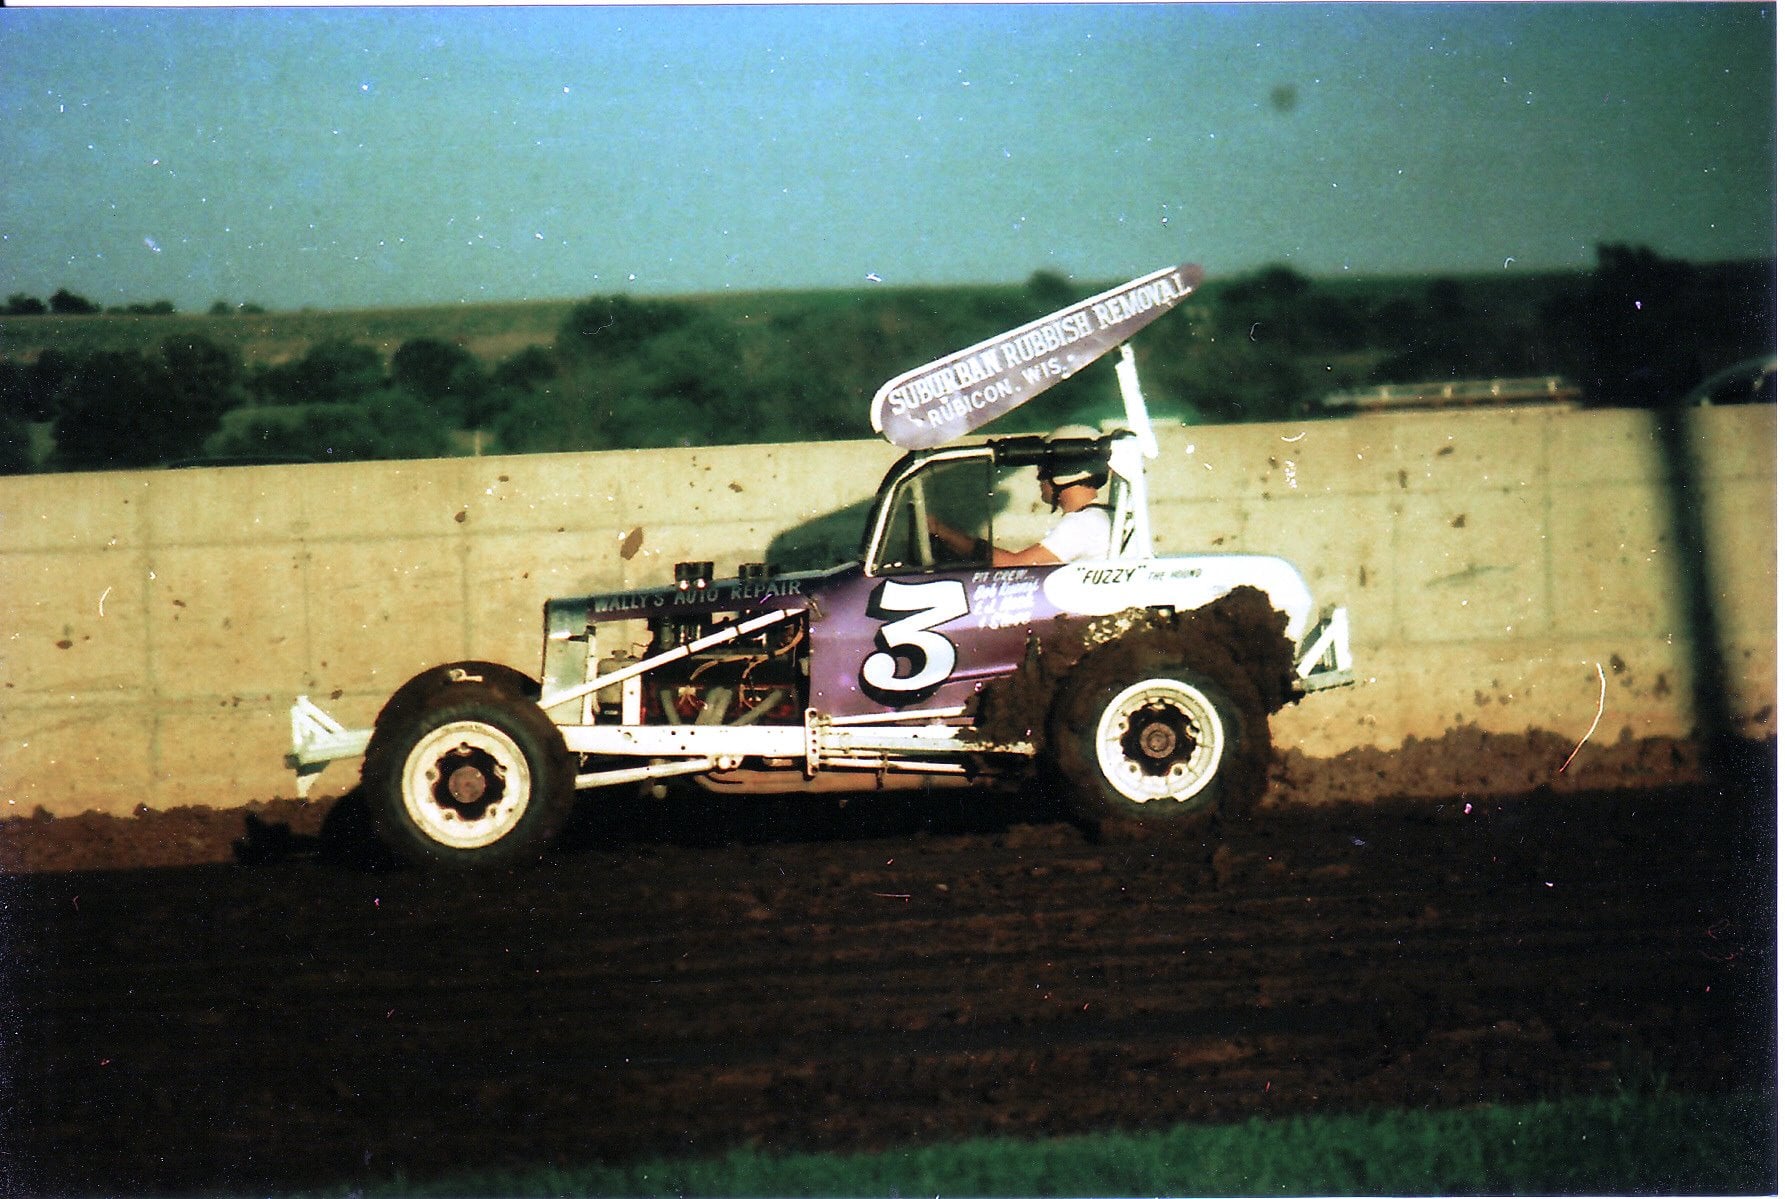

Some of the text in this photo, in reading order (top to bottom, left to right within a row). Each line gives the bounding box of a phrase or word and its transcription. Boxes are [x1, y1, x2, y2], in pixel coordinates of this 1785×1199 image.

[888, 273, 1192, 415] SUBURBAN RUBBISH REMOVAL
[594, 580, 801, 613] WALLY'S AUTO REPAIR
[858, 578, 970, 709] 3
